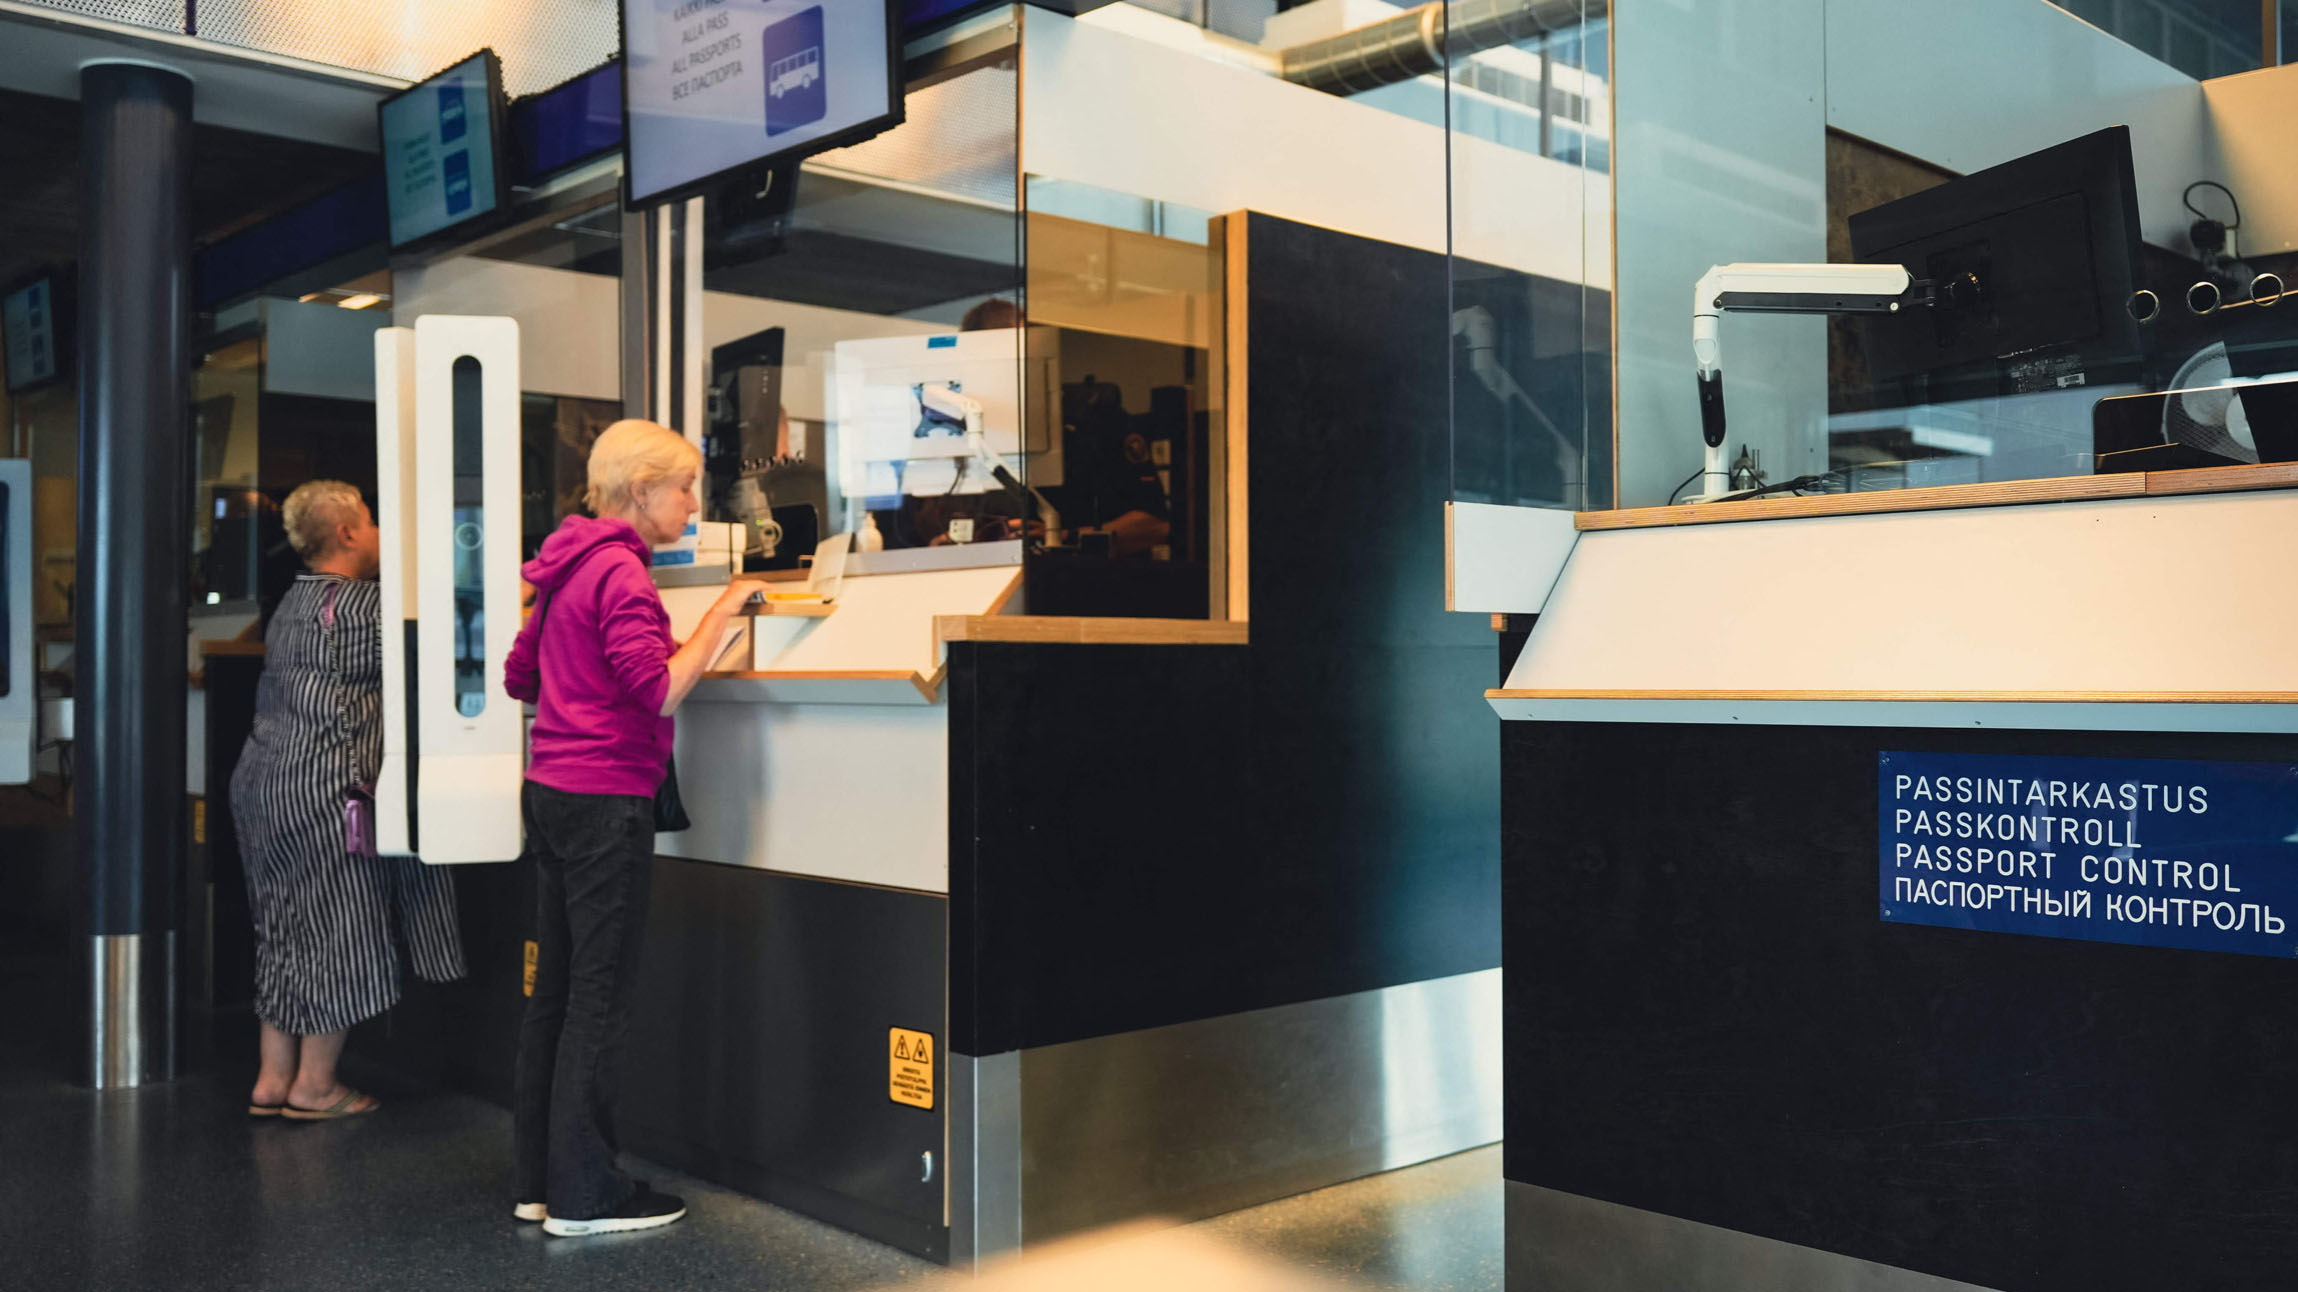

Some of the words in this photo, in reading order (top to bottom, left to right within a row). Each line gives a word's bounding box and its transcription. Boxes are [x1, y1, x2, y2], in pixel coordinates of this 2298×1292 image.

[682, 23, 704, 43] ALLA
[706, 10, 729, 32] PASS
[672, 58, 688, 75] ALL
[689, 32, 742, 66] PASSPORTS
[691, 59, 743, 94] ПАСПОРТА
[1896, 774, 2208, 814] PASSINTARKASTUS
[1896, 808, 2142, 849] PASSKONTROLL
[1896, 843, 2057, 879] PASSPORT
[2080, 855, 2241, 893] CONTROL
[1895, 876, 2091, 919] ПАСПОРТНЫЙ
[2106, 893, 2286, 934] КОНТРОЛЬ
